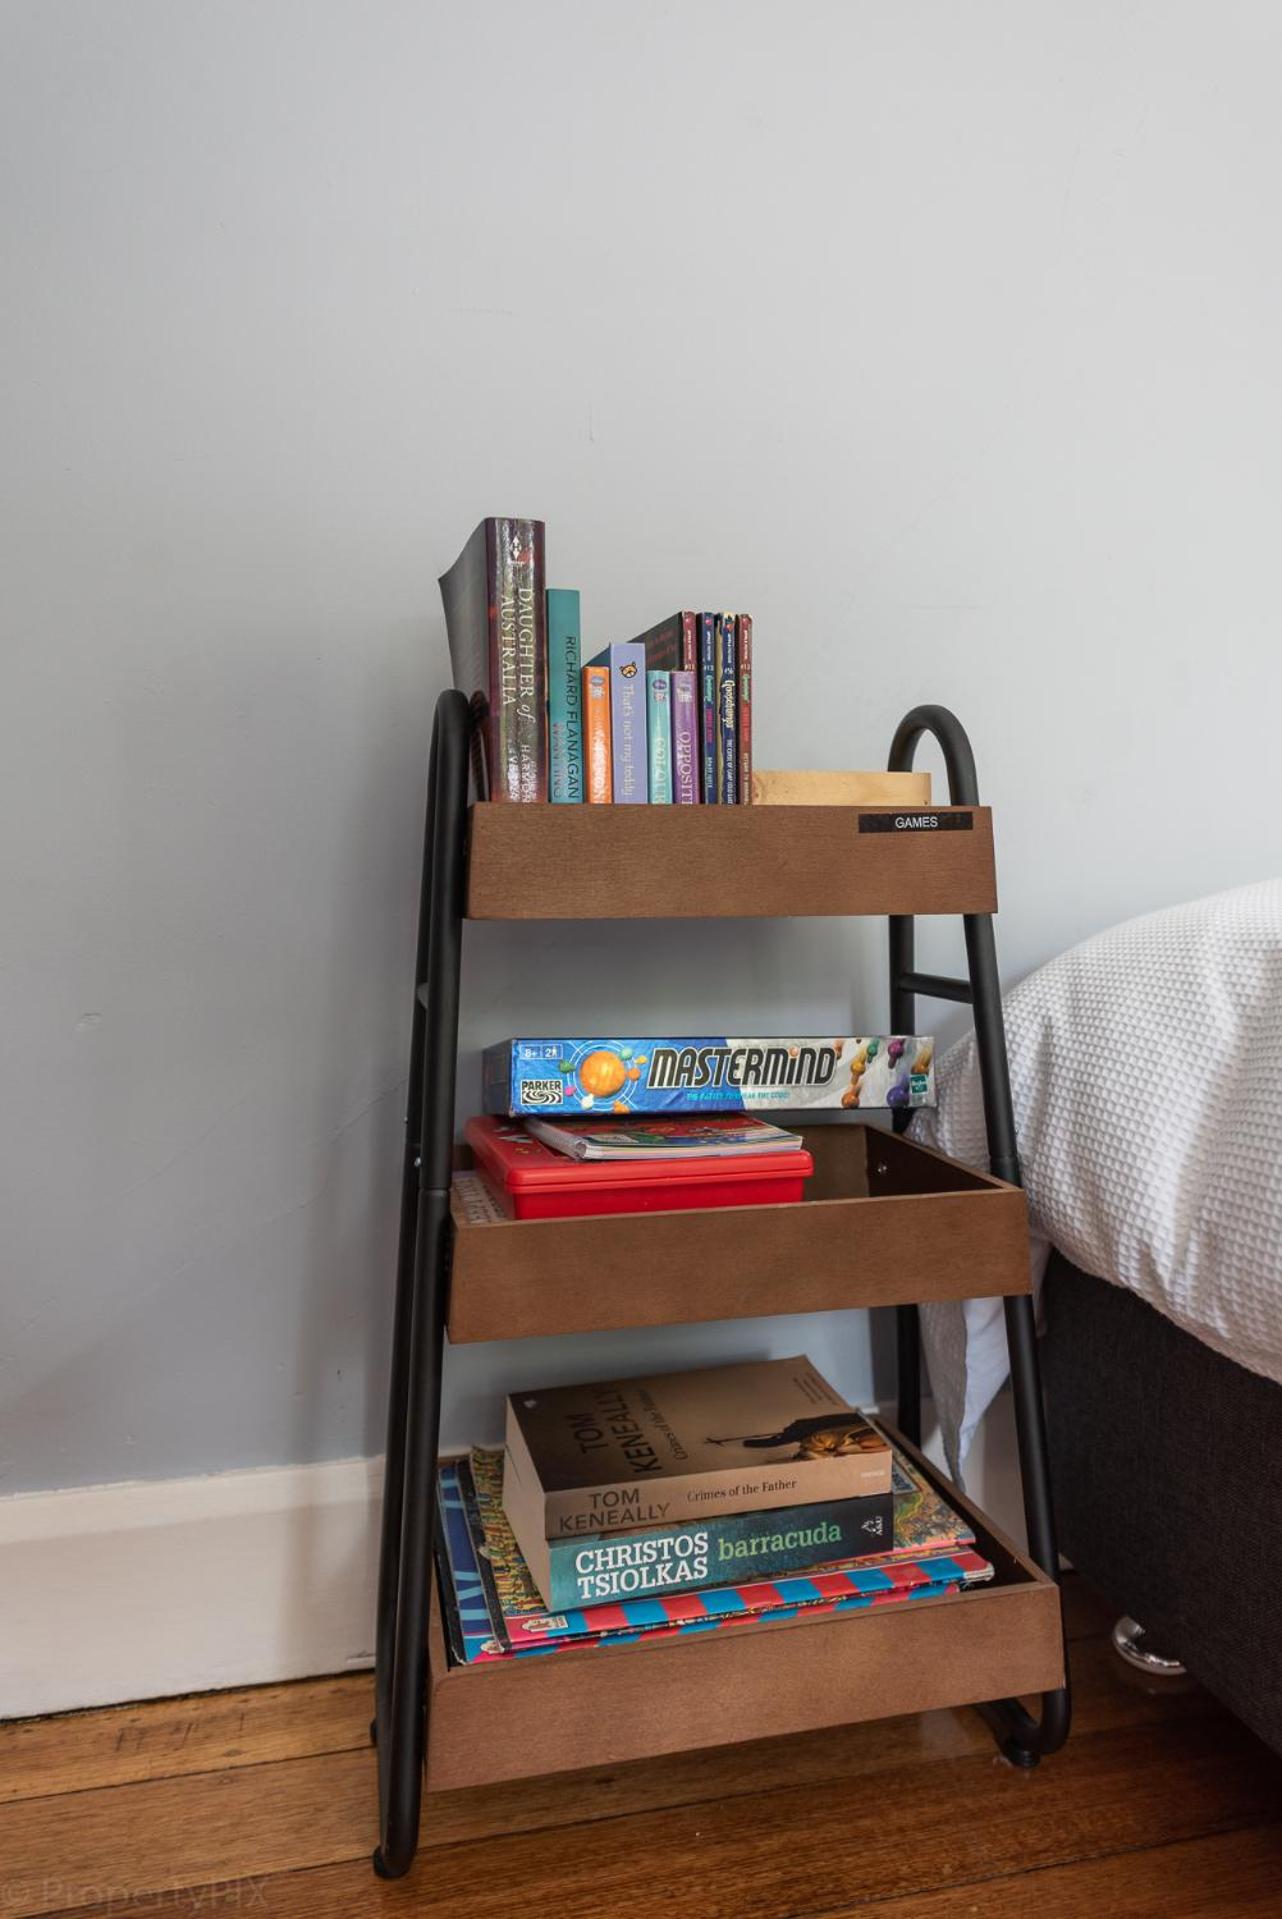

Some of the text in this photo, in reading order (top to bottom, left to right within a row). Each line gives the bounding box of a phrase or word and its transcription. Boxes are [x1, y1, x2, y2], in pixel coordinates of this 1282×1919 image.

[501, 595, 517, 706] AUSTRALIA
[514, 587, 536, 724] DAUGHTER of
[565, 636, 581, 799] RICHARD FLANAGAN
[623, 720, 634, 740] not
[619, 742, 633, 763] my
[620, 765, 636, 796] teddy
[895, 816, 939, 829] GAMES
[646, 1045, 837, 1090] MASTERMIND
[521, 1081, 563, 1094] PARKER
[564, 1412, 609, 1455] TOM
[589, 1487, 640, 1509] TOM
[687, 1478, 798, 1503] Crimes of the Father
[561, 1502, 671, 1532] KENEALLY
[575, 1522, 843, 1574] CHRISTOS barracuda
[577, 1557, 708, 1600] TSIOLKAS
